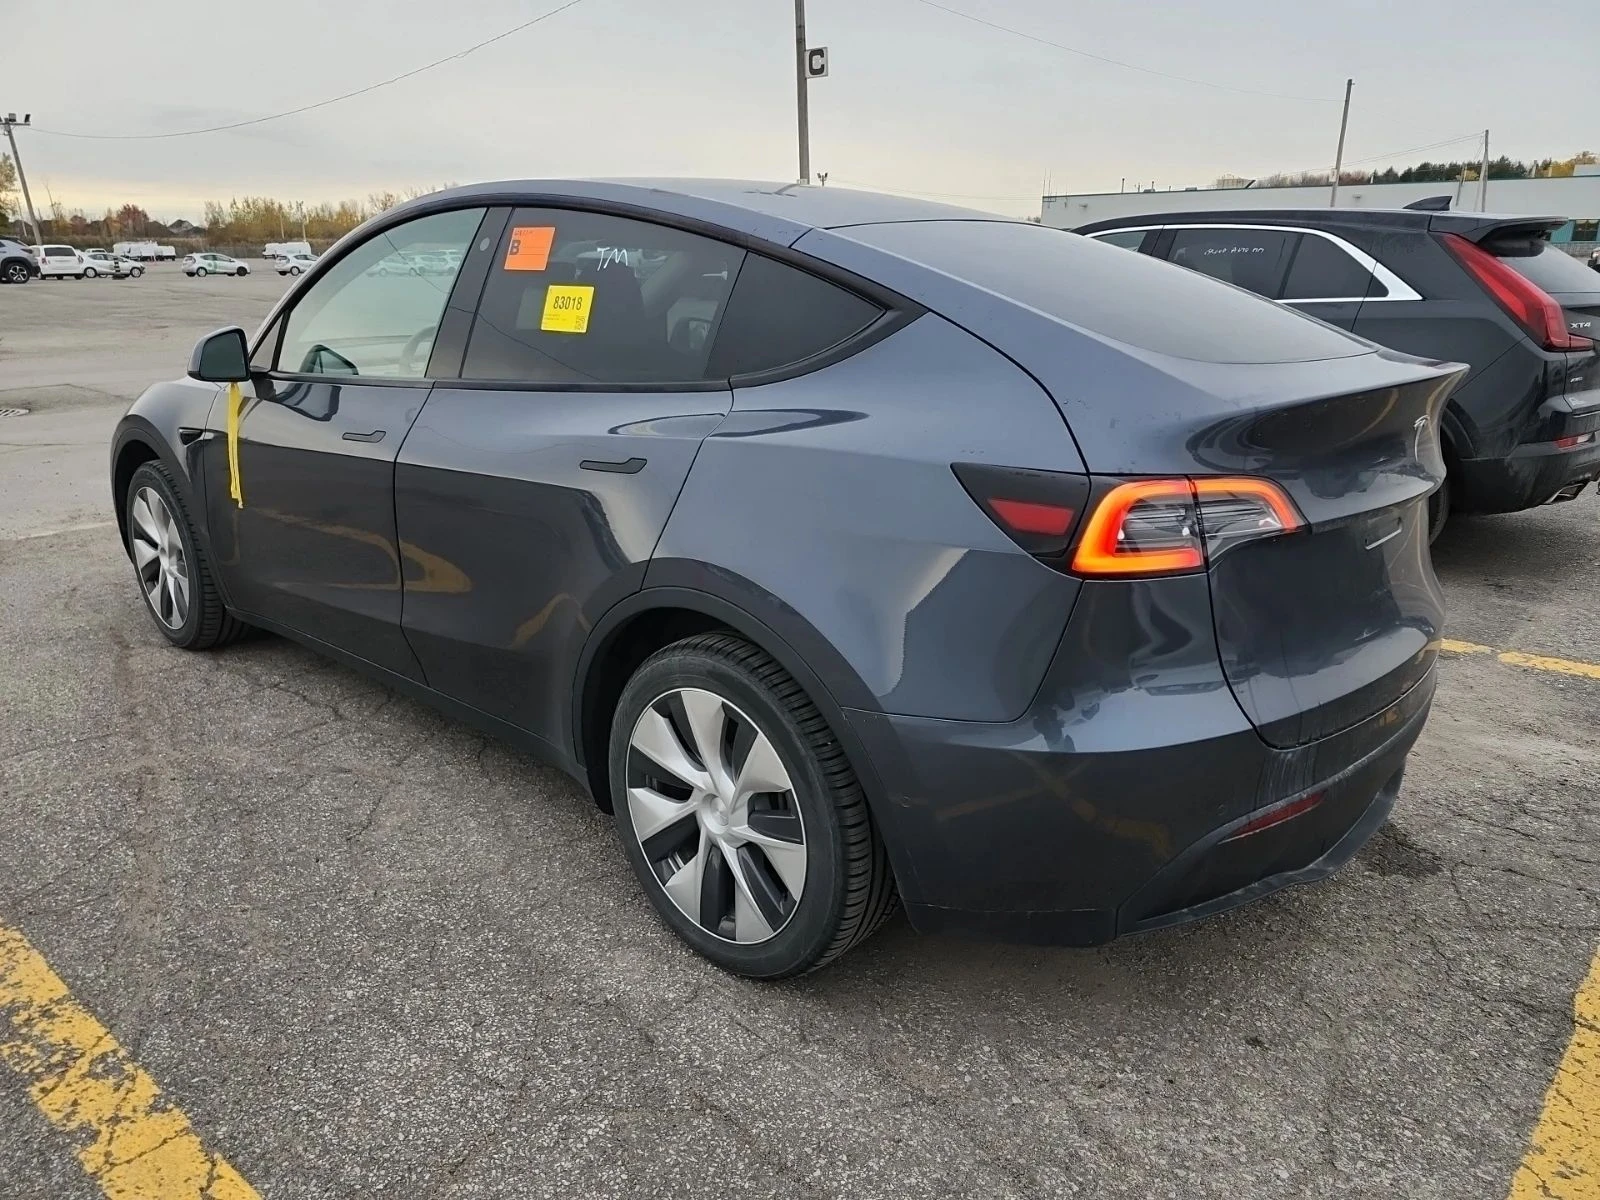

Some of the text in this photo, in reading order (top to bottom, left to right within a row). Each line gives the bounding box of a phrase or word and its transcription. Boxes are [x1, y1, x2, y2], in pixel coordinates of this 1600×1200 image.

[809, 49, 825, 75] C
[509, 240, 521, 255] B
[597, 247, 628, 271] TM
[553, 296, 582, 310] 83018
